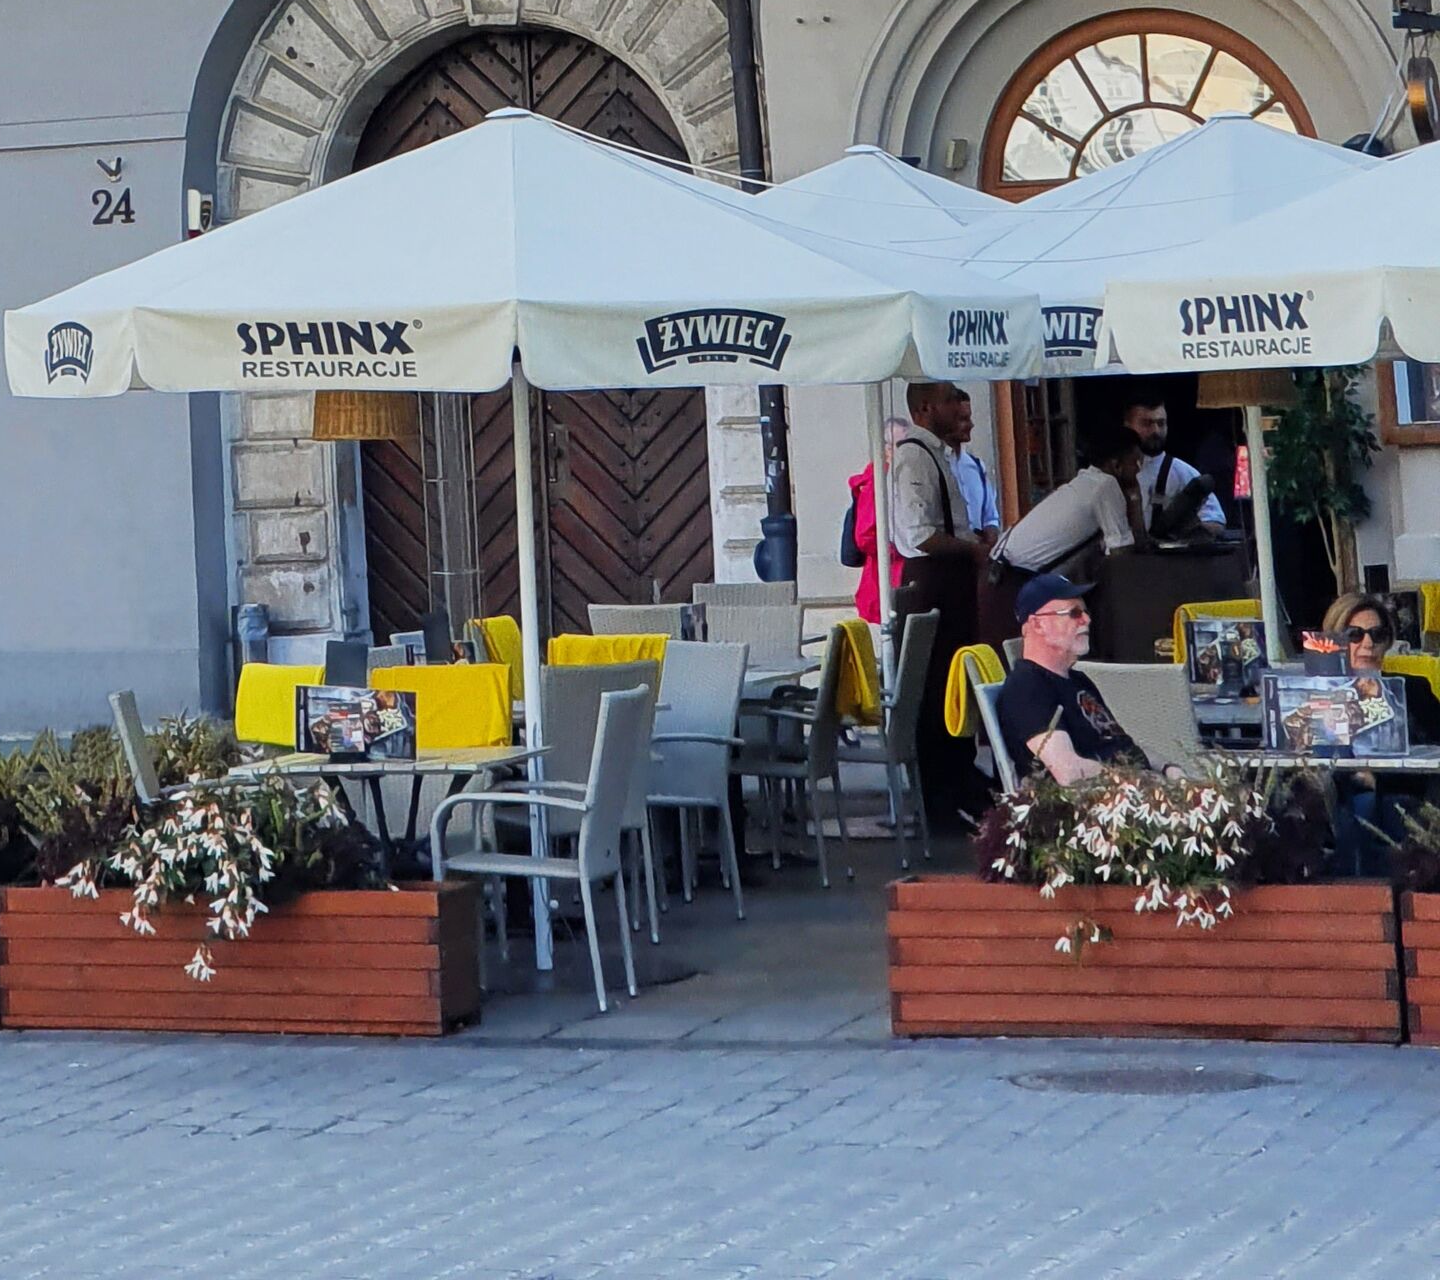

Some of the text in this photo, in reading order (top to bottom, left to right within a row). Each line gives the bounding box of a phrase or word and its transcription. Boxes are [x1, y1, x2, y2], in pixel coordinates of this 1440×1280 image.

[92, 187, 136, 225] 24
[657, 314, 775, 352] ŻYWIEC
[1182, 337, 1312, 359] RESTAURACJE
[242, 361, 417, 378] RESTAURACJE
[947, 351, 1010, 368] RESTAURACJE
